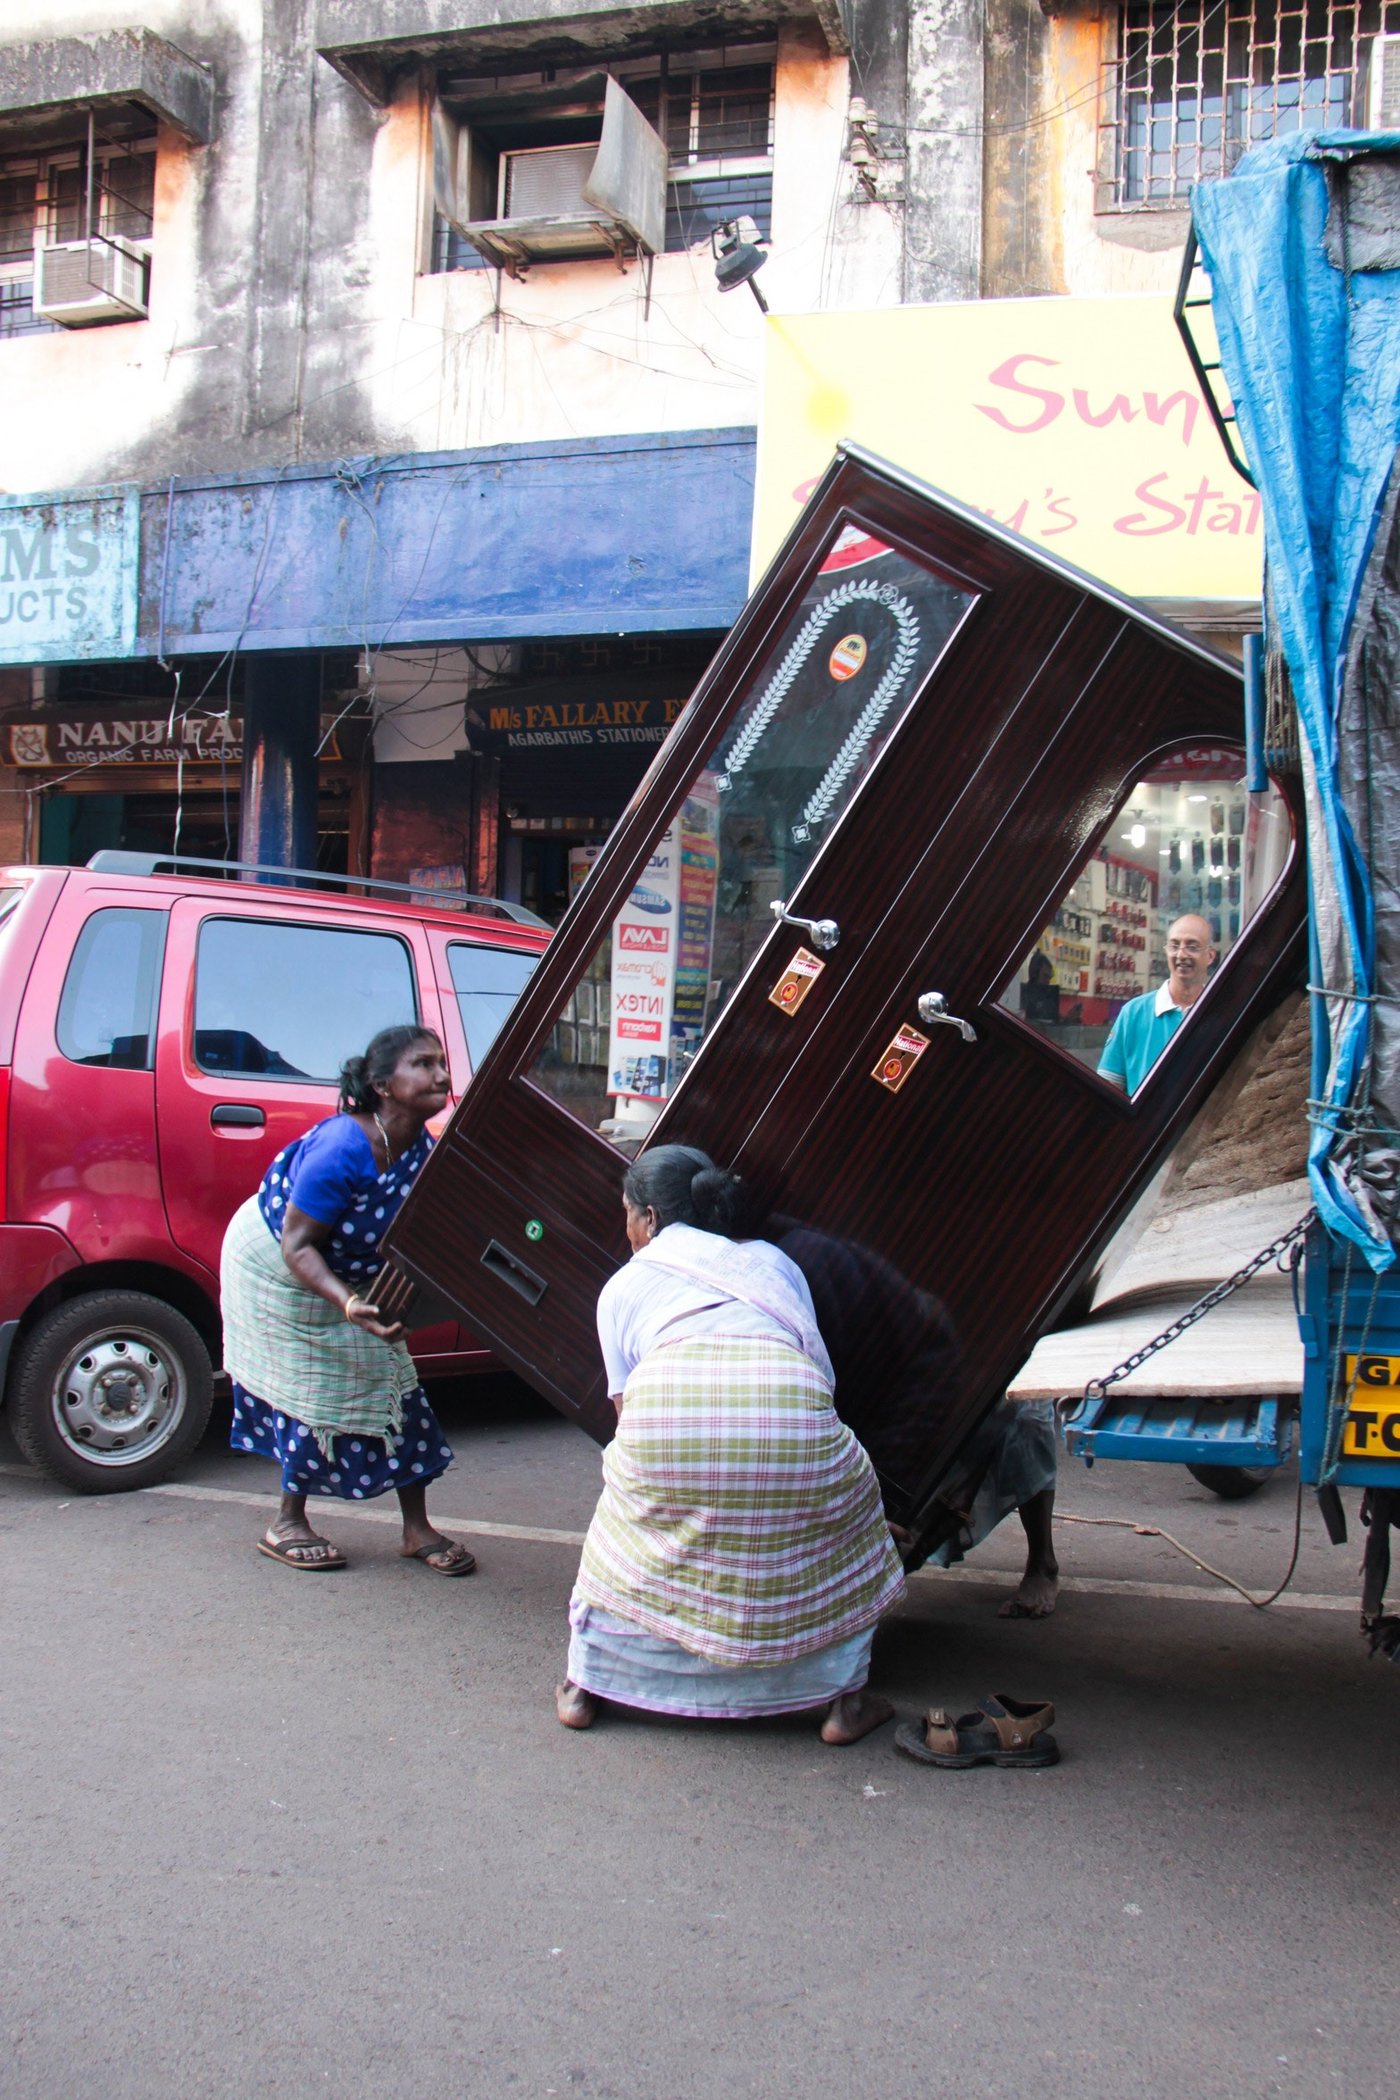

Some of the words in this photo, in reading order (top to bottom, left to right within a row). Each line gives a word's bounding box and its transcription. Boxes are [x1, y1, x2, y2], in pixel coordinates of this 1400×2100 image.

[525, 701, 648, 728] FALLARY
[58, 720, 168, 747] NANU
[182, 718, 243, 744] FA
[508, 729, 593, 747] AGARBATHIS
[66, 750, 134, 763] ORGANIC
[141, 748, 191, 761] FARM
[894, 1036, 926, 1053] National
[1359, 1357, 1400, 1386] G
